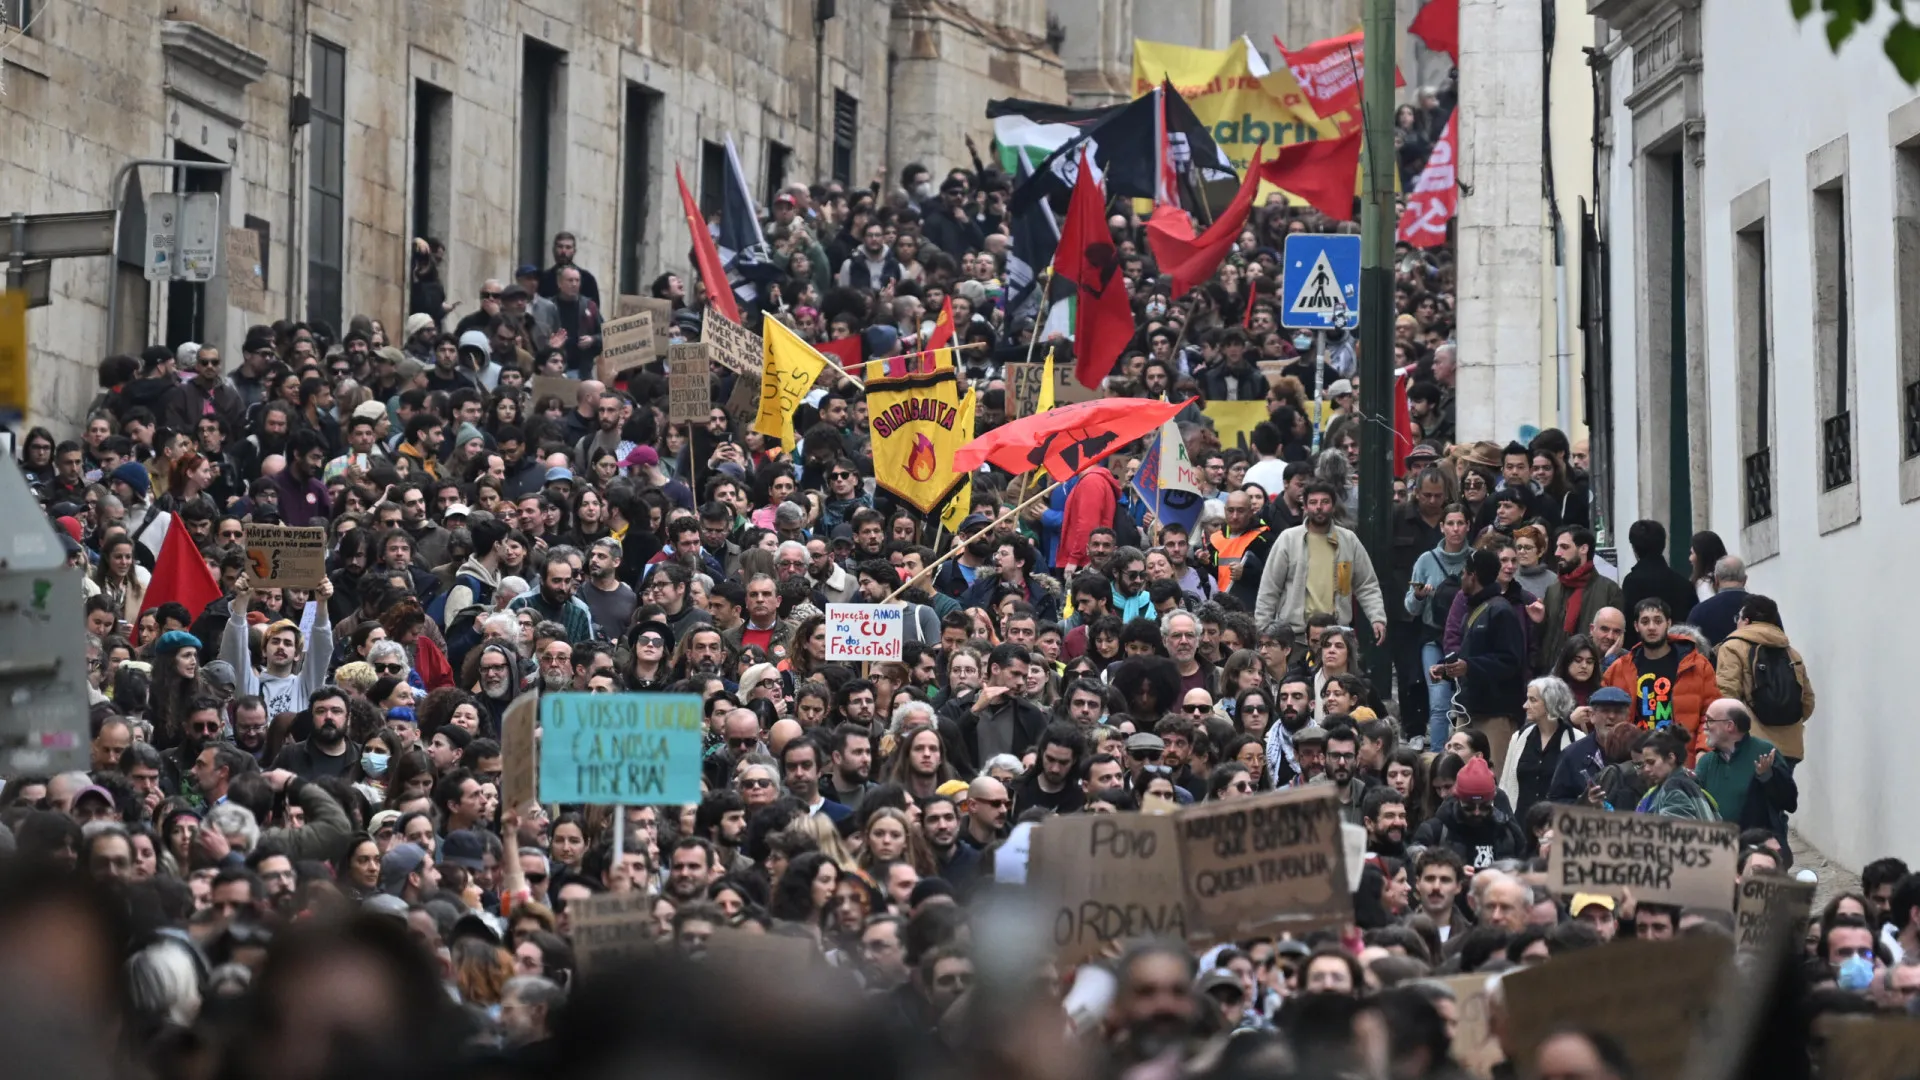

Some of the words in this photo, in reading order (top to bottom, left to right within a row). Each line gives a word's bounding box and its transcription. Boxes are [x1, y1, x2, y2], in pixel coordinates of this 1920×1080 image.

[603, 316, 649, 337] FLEXIBILIZAR
[707, 318, 733, 342] VIVER
[707, 329, 733, 355] VIVER
[872, 397, 957, 438] SIRIGAITA
[261, 529, 281, 538] LEVO
[283, 530, 292, 538] NO
[293, 531, 322, 540] PACOTE
[830, 608, 870, 623] Injecção
[873, 608, 901, 620] AMOR
[836, 624, 850, 633] no
[860, 621, 887, 636] CU
[845, 635, 860, 646] dos
[552, 699, 565, 729] O
[576, 700, 639, 730] VOSSO
[644, 700, 700, 730] LUCRO
[588, 732, 605, 762] A
[612, 733, 670, 766] NOSSA
[1558, 814, 1659, 840] QUEREMOS
[1562, 835, 1600, 858] NÃO
[1607, 843, 1711, 869] QUEREMOS
[1196, 863, 1255, 898] QUEM
[1562, 860, 1674, 890] EMIGRAR
[1054, 900, 1187, 947] ORDENA
